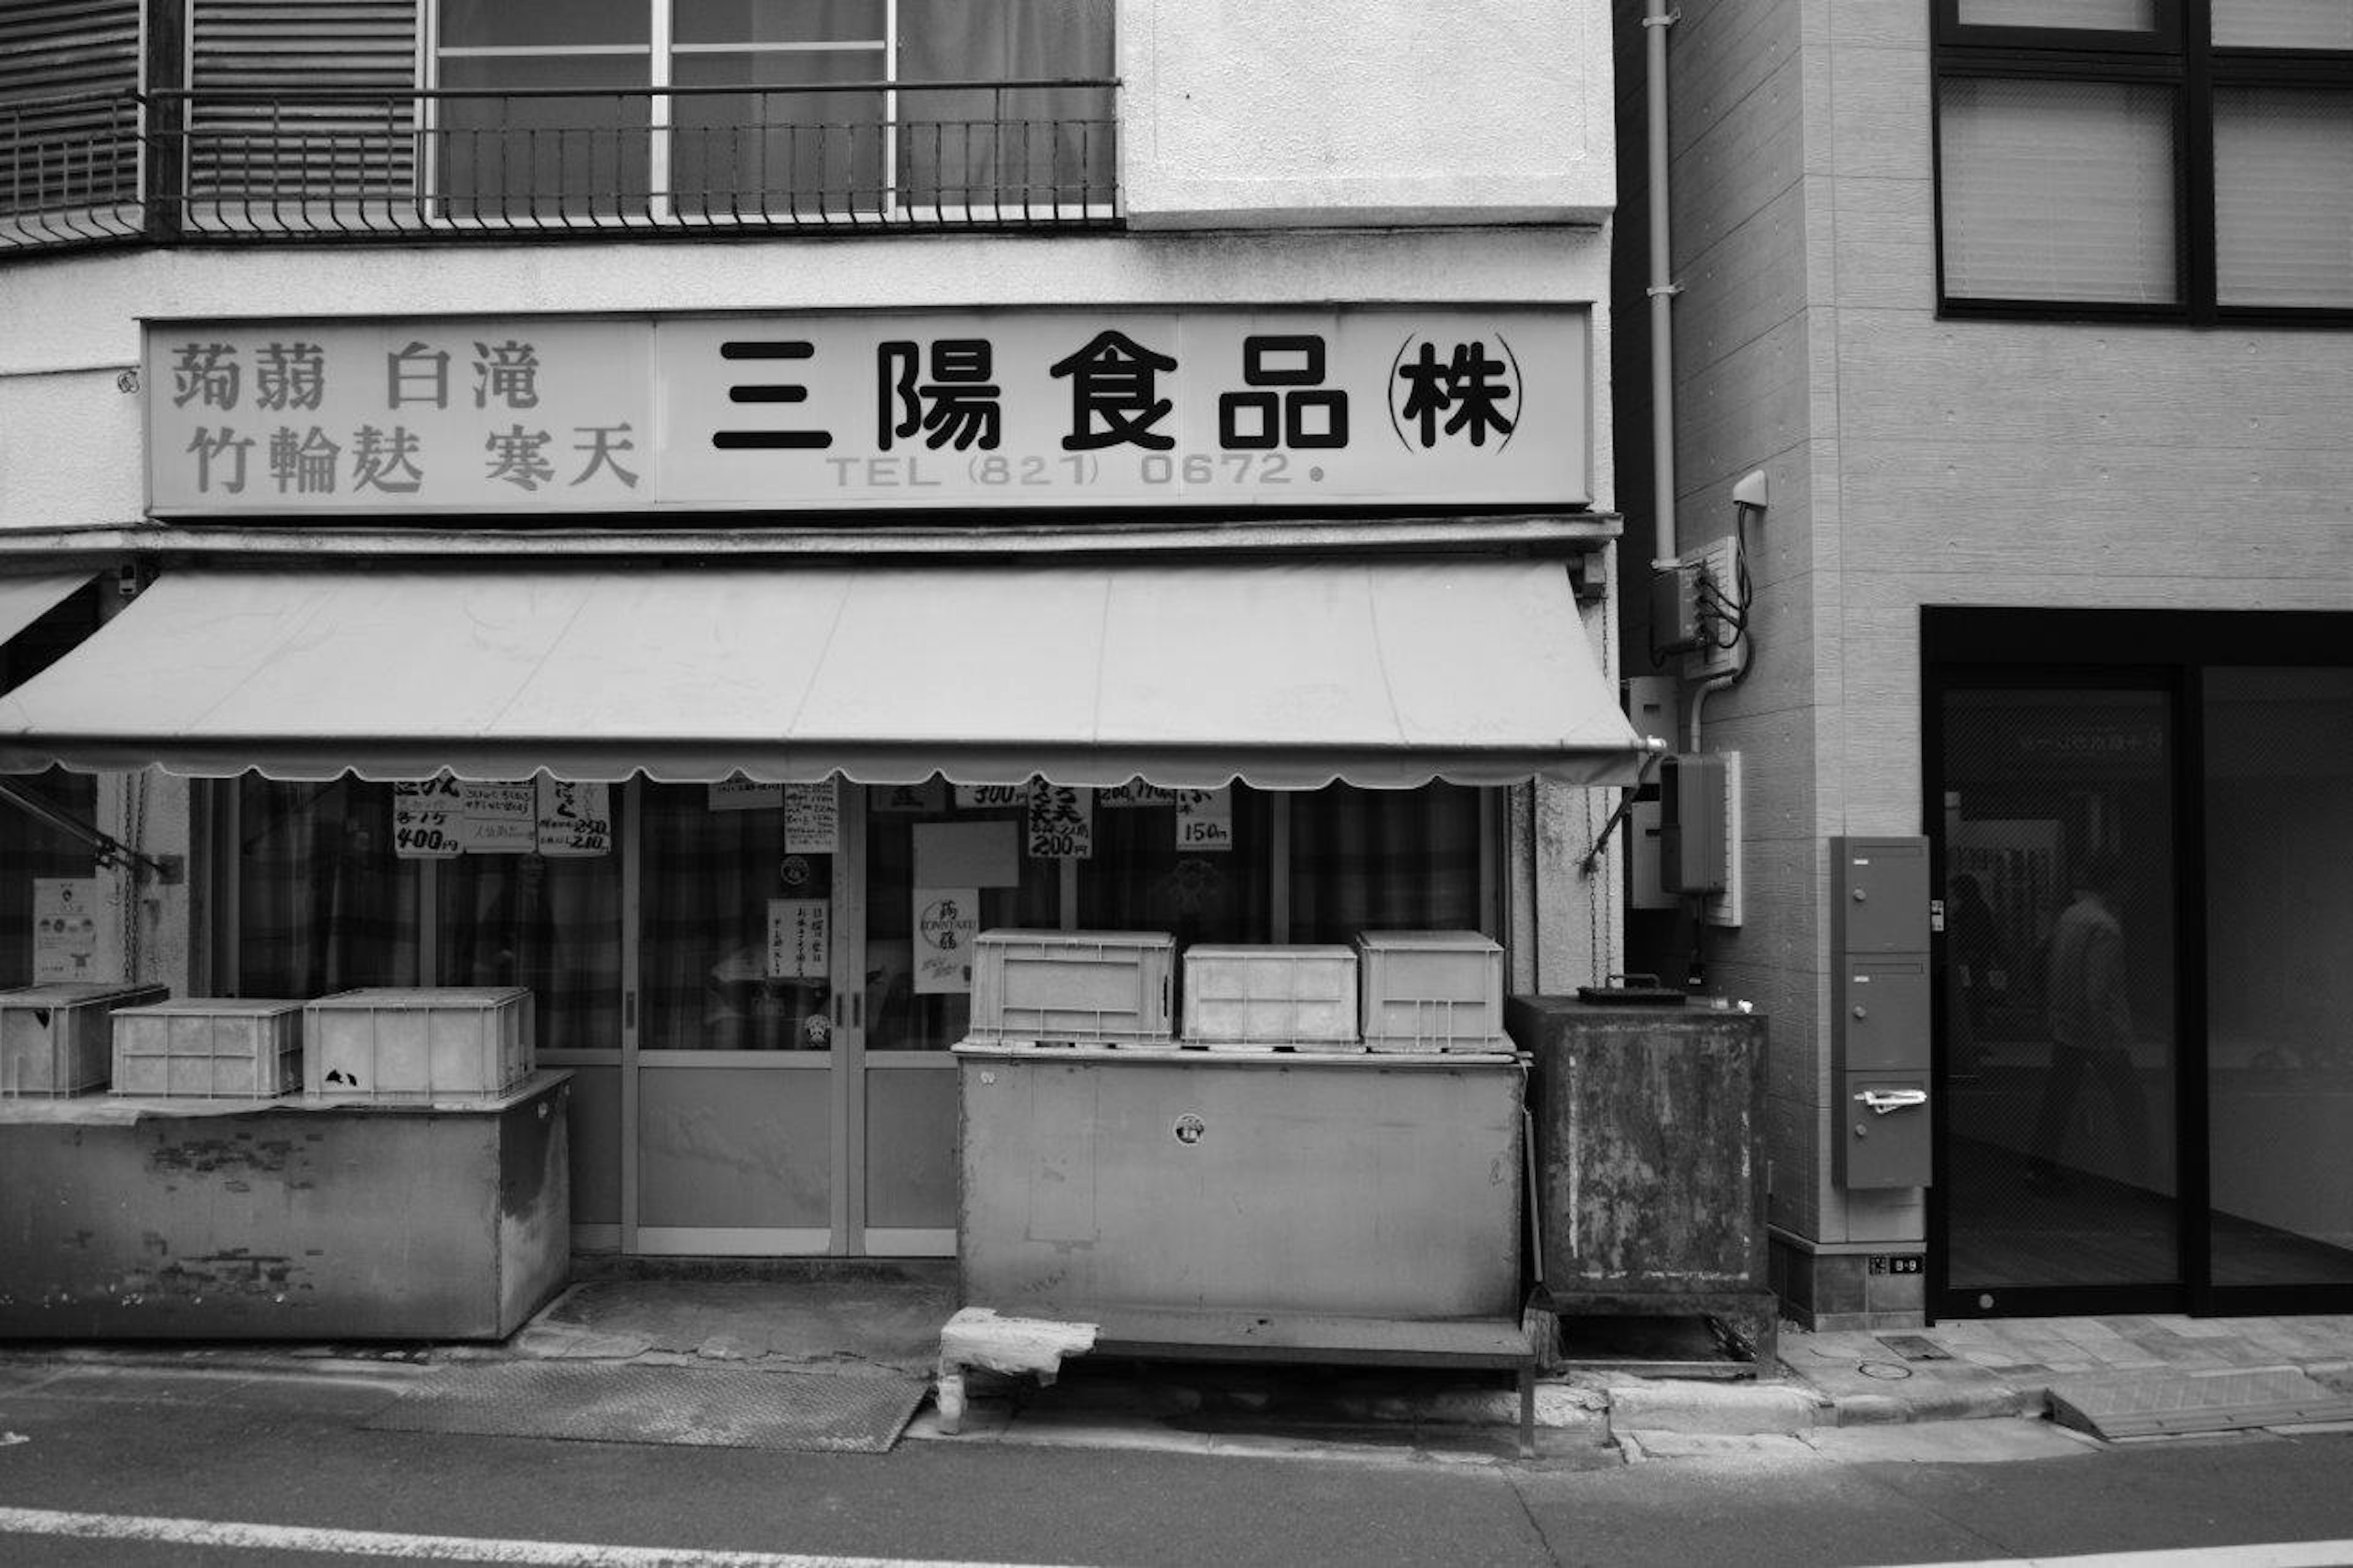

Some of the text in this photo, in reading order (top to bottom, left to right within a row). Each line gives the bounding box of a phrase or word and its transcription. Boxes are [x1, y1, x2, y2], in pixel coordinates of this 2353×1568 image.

[386, 339, 540, 410] 白滝
[485, 422, 639, 491] 寒天
[825, 456, 941, 487] TEL
